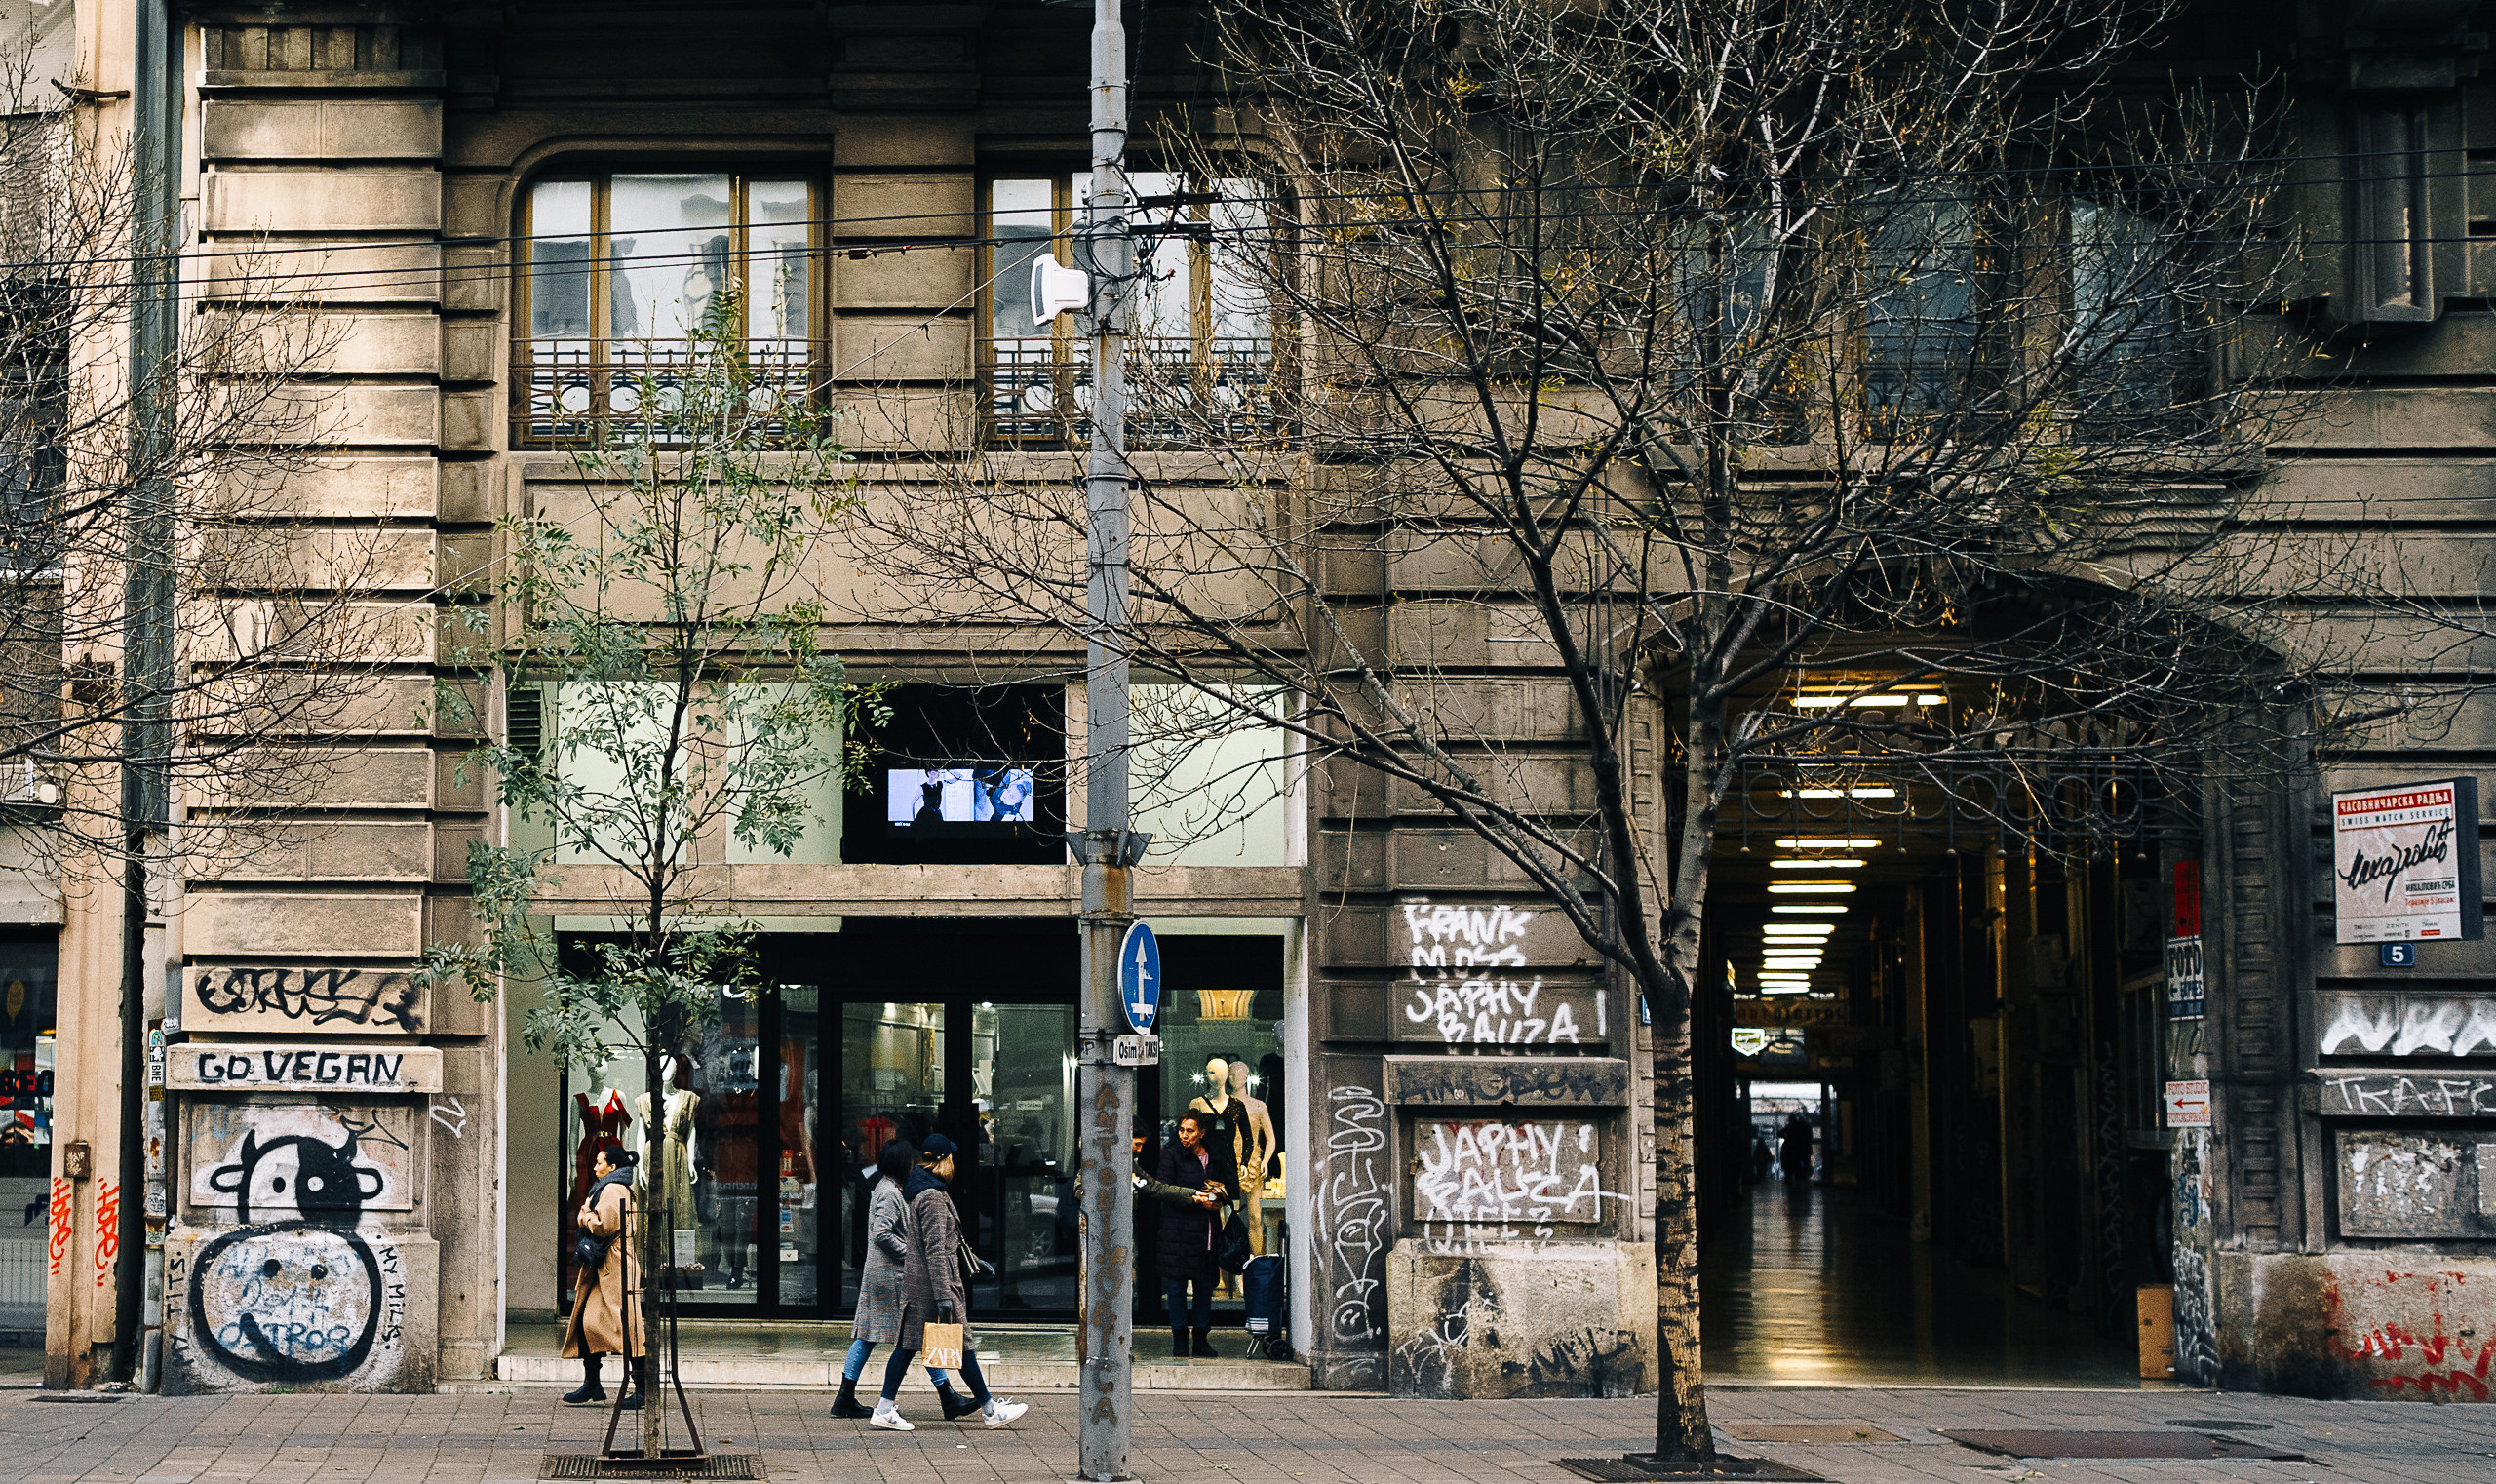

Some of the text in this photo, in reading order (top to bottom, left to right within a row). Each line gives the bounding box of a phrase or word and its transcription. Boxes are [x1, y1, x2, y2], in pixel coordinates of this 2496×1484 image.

[2340, 791, 2449, 812] ЧАСОВНИЧАРСКА РАДЊА
[2341, 808, 2450, 826] SWISS WATCH SERVICE
[1404, 904, 1533, 946] FRANK
[2168, 944, 2202, 978] FOTO
[2391, 946, 2405, 963] 5
[1406, 976, 1542, 1023] JAPHY
[1118, 1041, 1137, 1059] Osim
[1145, 1040, 1158, 1058] TAKSI
[151, 1065, 162, 1082] BNE
[198, 1050, 404, 1084] GO VEGAN
[1421, 1123, 1564, 1177] JAPHY
[379, 1245, 398, 1274] MY
[925, 1347, 963, 1367] ZARA
